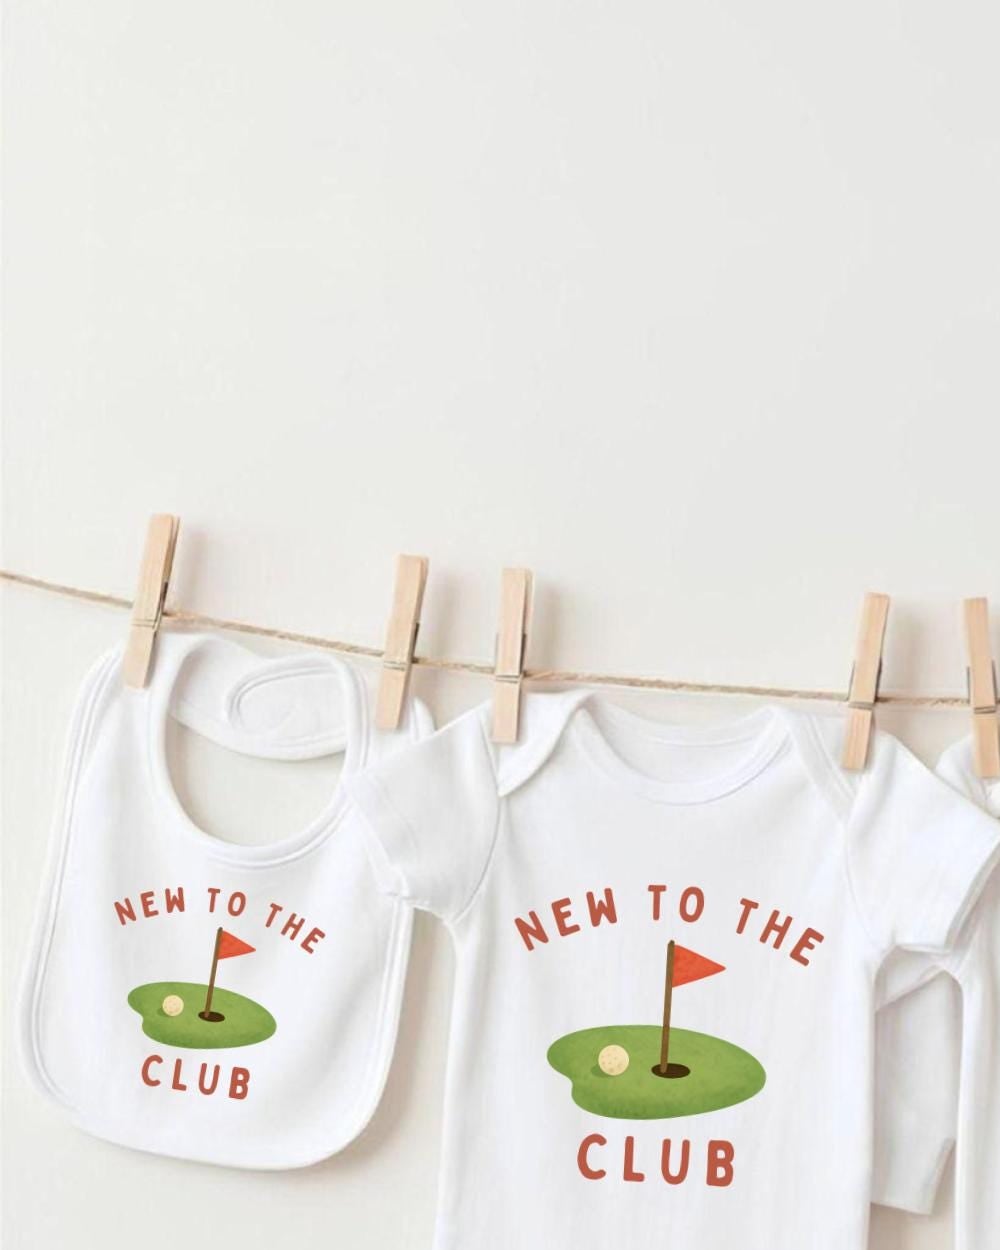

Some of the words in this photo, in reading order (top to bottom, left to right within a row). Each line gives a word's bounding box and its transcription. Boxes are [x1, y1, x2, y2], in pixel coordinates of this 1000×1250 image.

[114, 888, 185, 925] NEW
[208, 887, 247, 917] TO
[266, 902, 325, 954] THE
[514, 886, 618, 951] NEW
[648, 884, 705, 923] TO
[736, 898, 824, 966] THE
[140, 1055, 251, 1101] CLUB
[576, 1132, 735, 1188] CLUB
